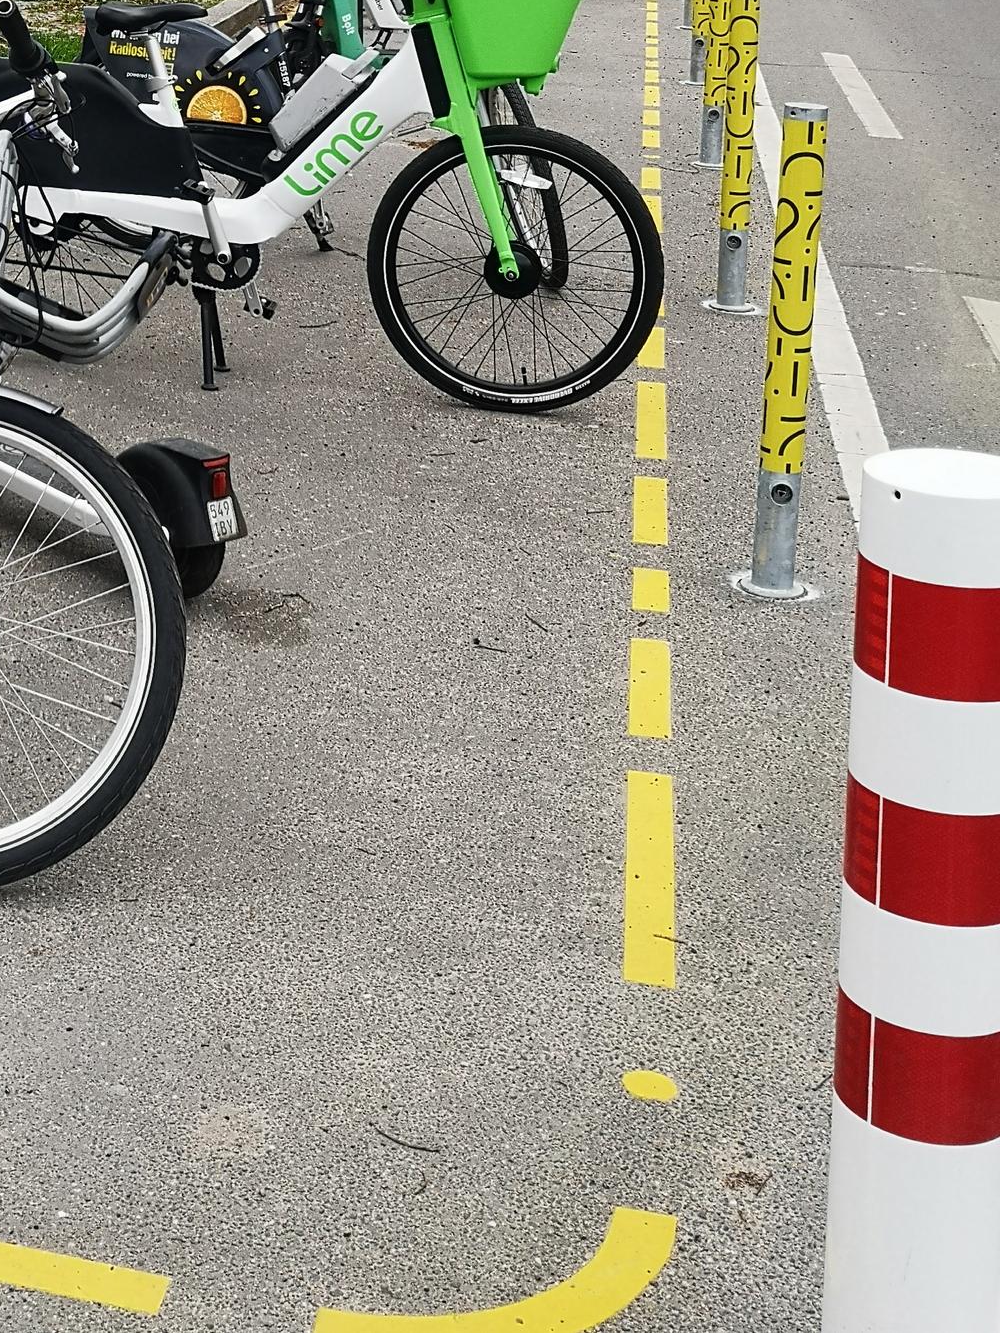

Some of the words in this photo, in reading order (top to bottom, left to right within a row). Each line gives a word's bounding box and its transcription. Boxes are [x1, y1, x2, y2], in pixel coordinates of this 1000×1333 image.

[341, 13, 354, 36] Bolt
[163, 29, 180, 45] bei
[109, 41, 176, 61] Radlosieit!
[278, 60, 291, 87] 15187
[282, 110, 384, 197] Lime
[209, 501, 230, 519] 549
[214, 518, 234, 538] IBY
